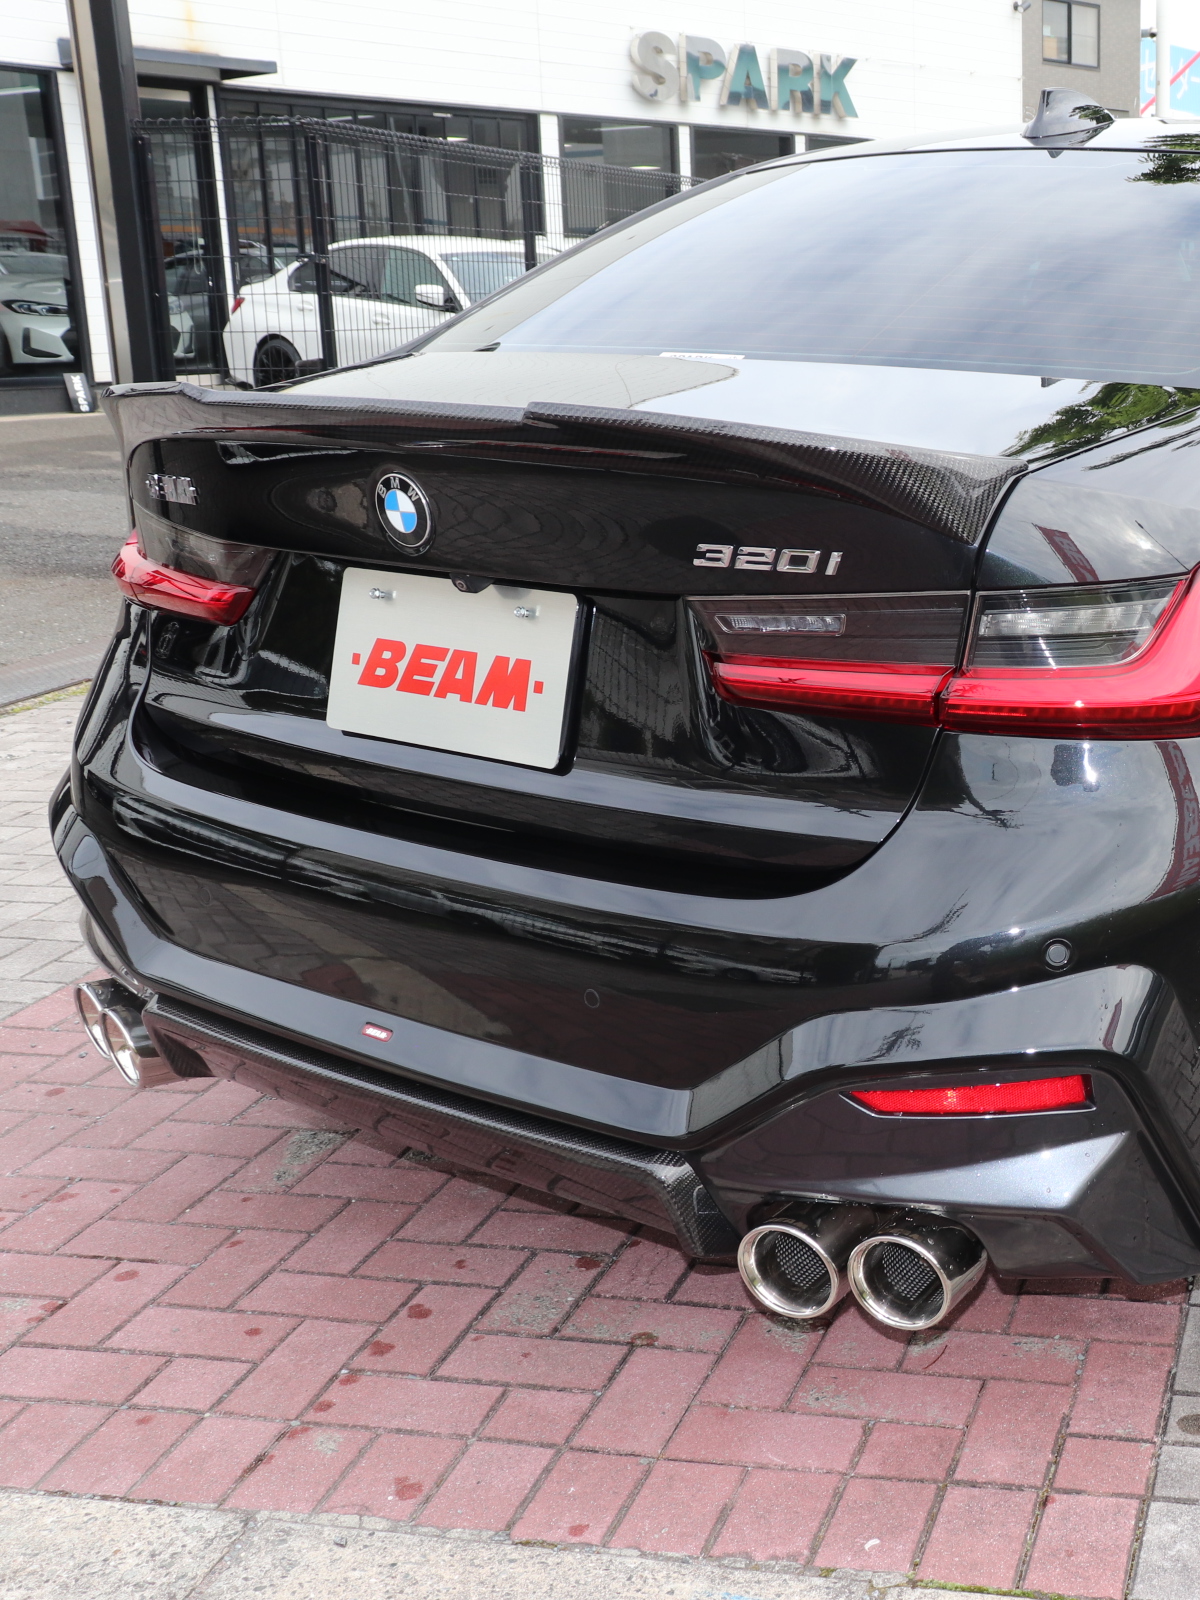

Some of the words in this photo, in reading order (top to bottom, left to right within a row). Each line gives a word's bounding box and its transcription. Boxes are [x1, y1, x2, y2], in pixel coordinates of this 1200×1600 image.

[630, 31, 858, 118] SPARK
[70, 375, 90, 412] SPARK
[377, 476, 420, 502] BMW
[693, 543, 844, 576] 320i
[356, 637, 533, 713] BEAM
